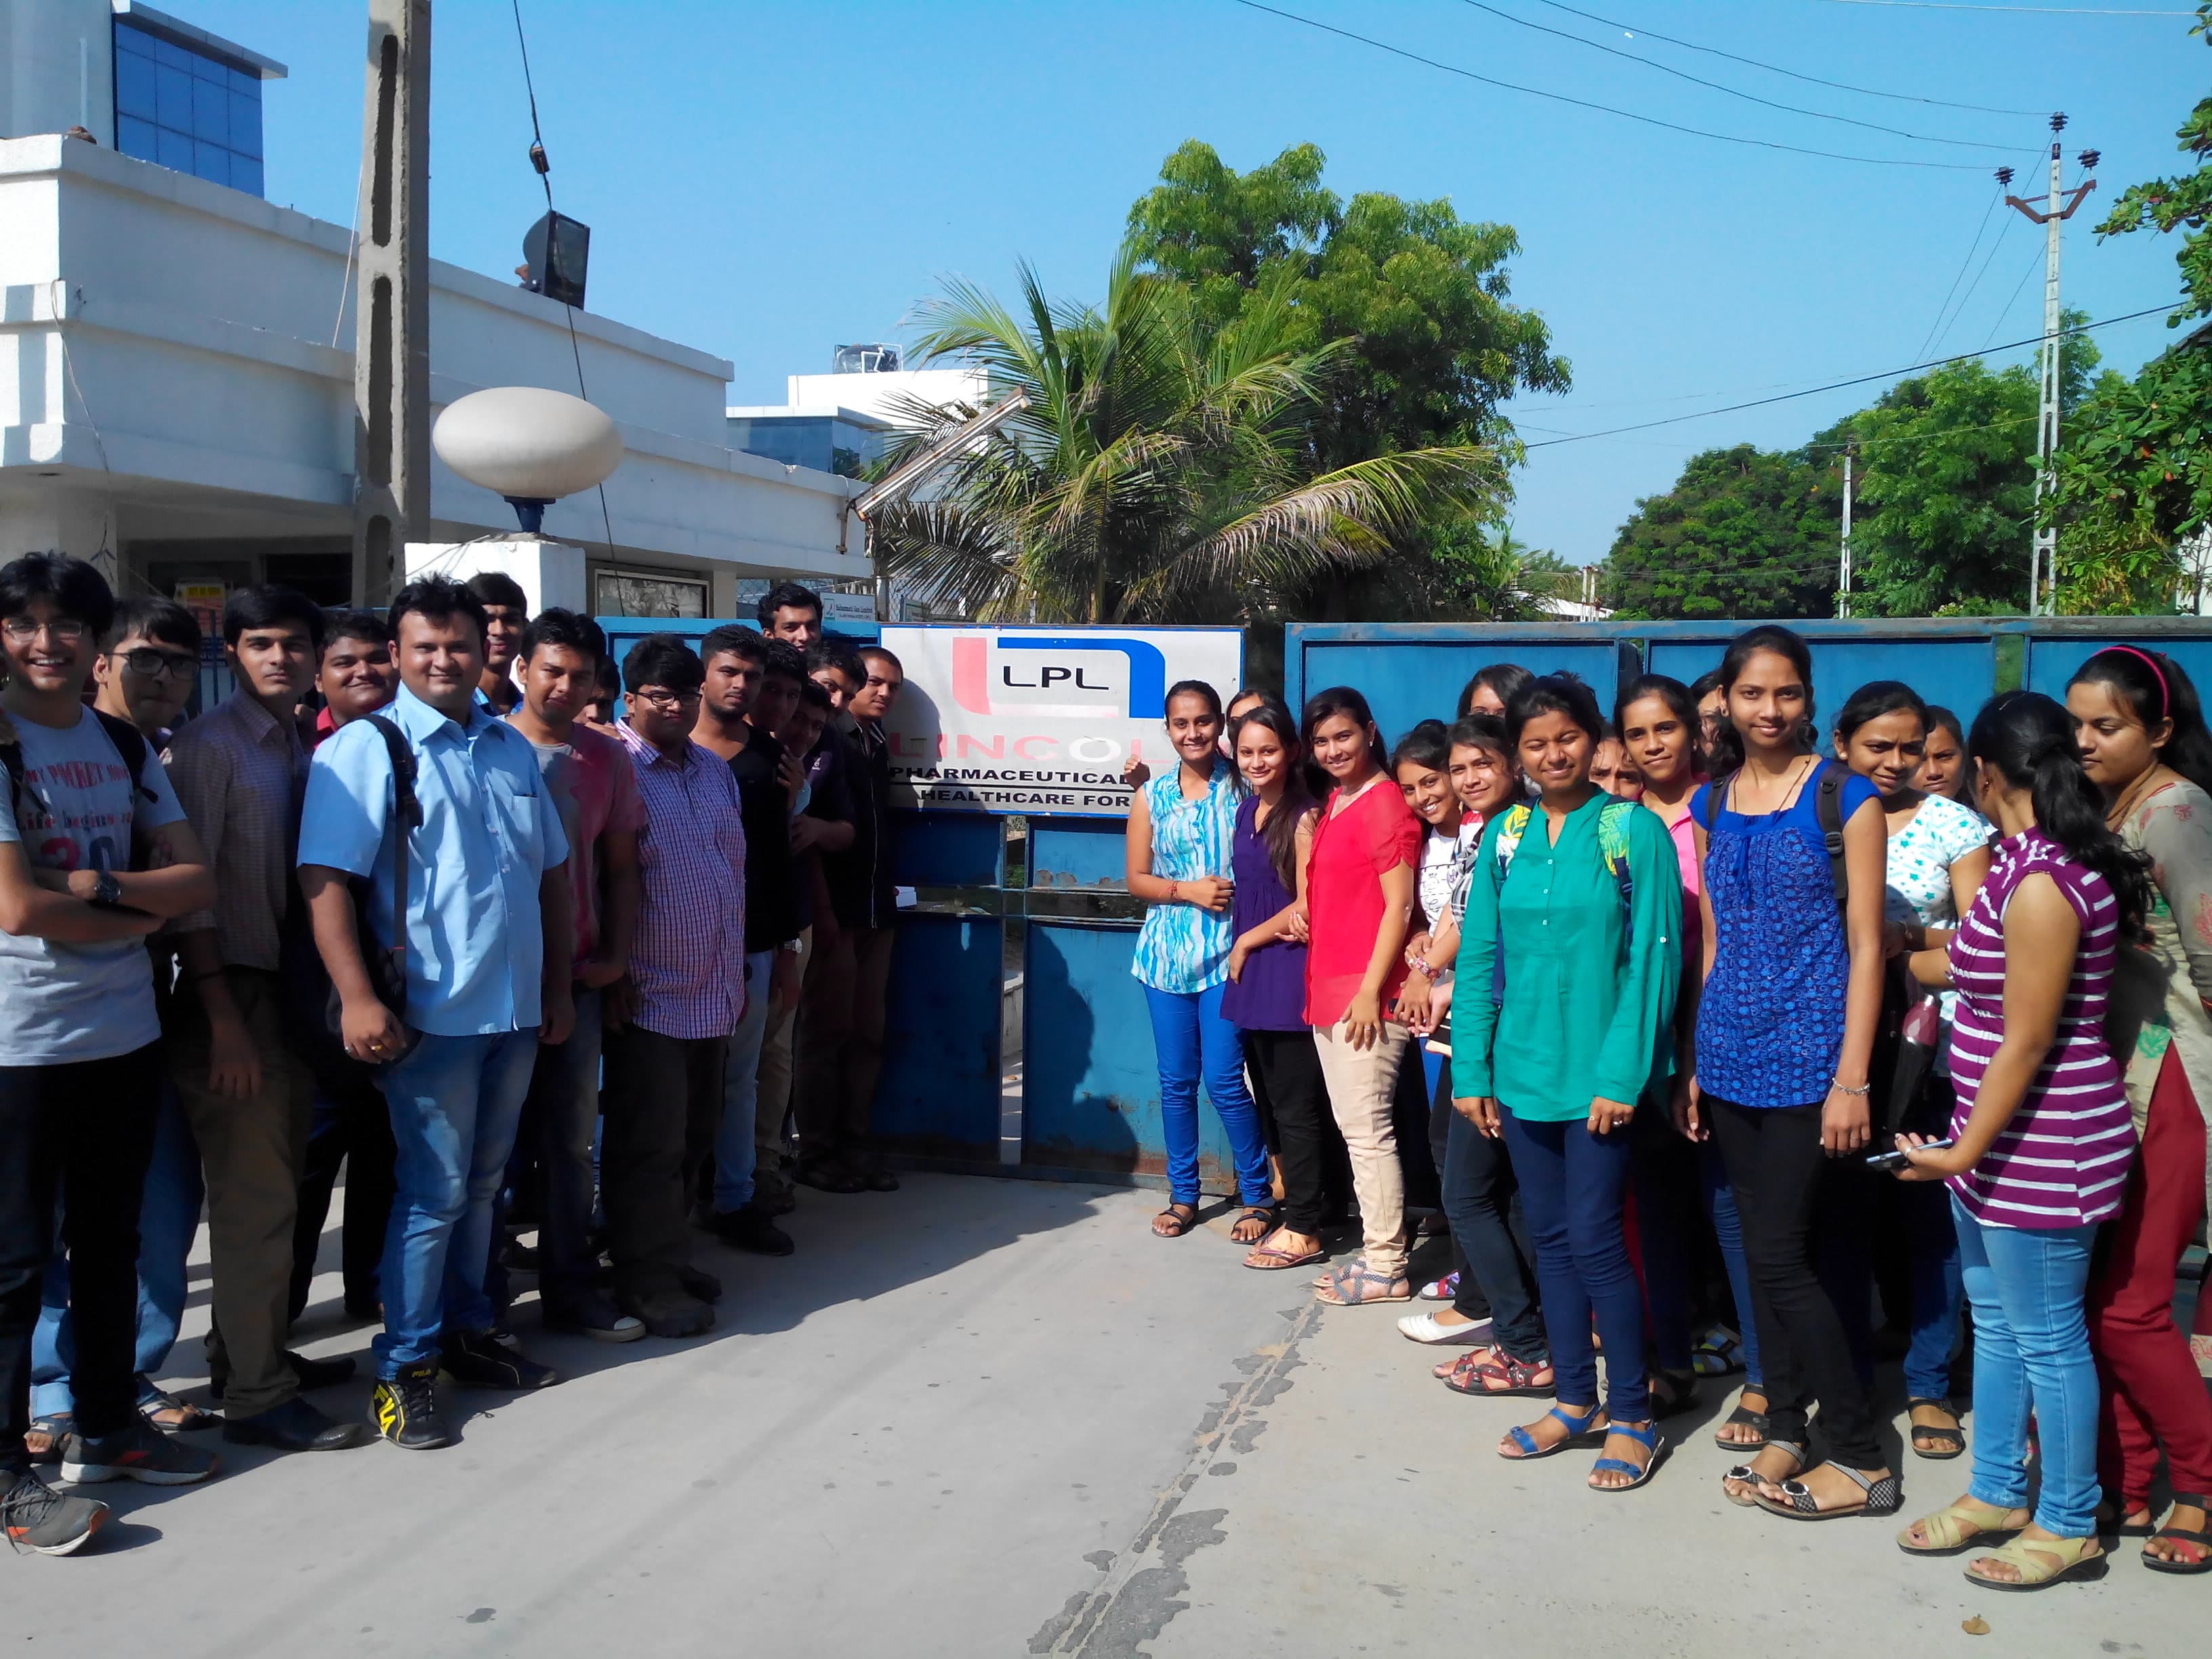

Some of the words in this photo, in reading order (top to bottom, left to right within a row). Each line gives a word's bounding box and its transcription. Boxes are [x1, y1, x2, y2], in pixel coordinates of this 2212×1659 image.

[1004, 665, 1109, 690] LPL
[890, 733, 1230, 763] LINCOL
[922, 790, 1075, 805] HEALTHCARE
[1084, 795, 1130, 806] FOR
